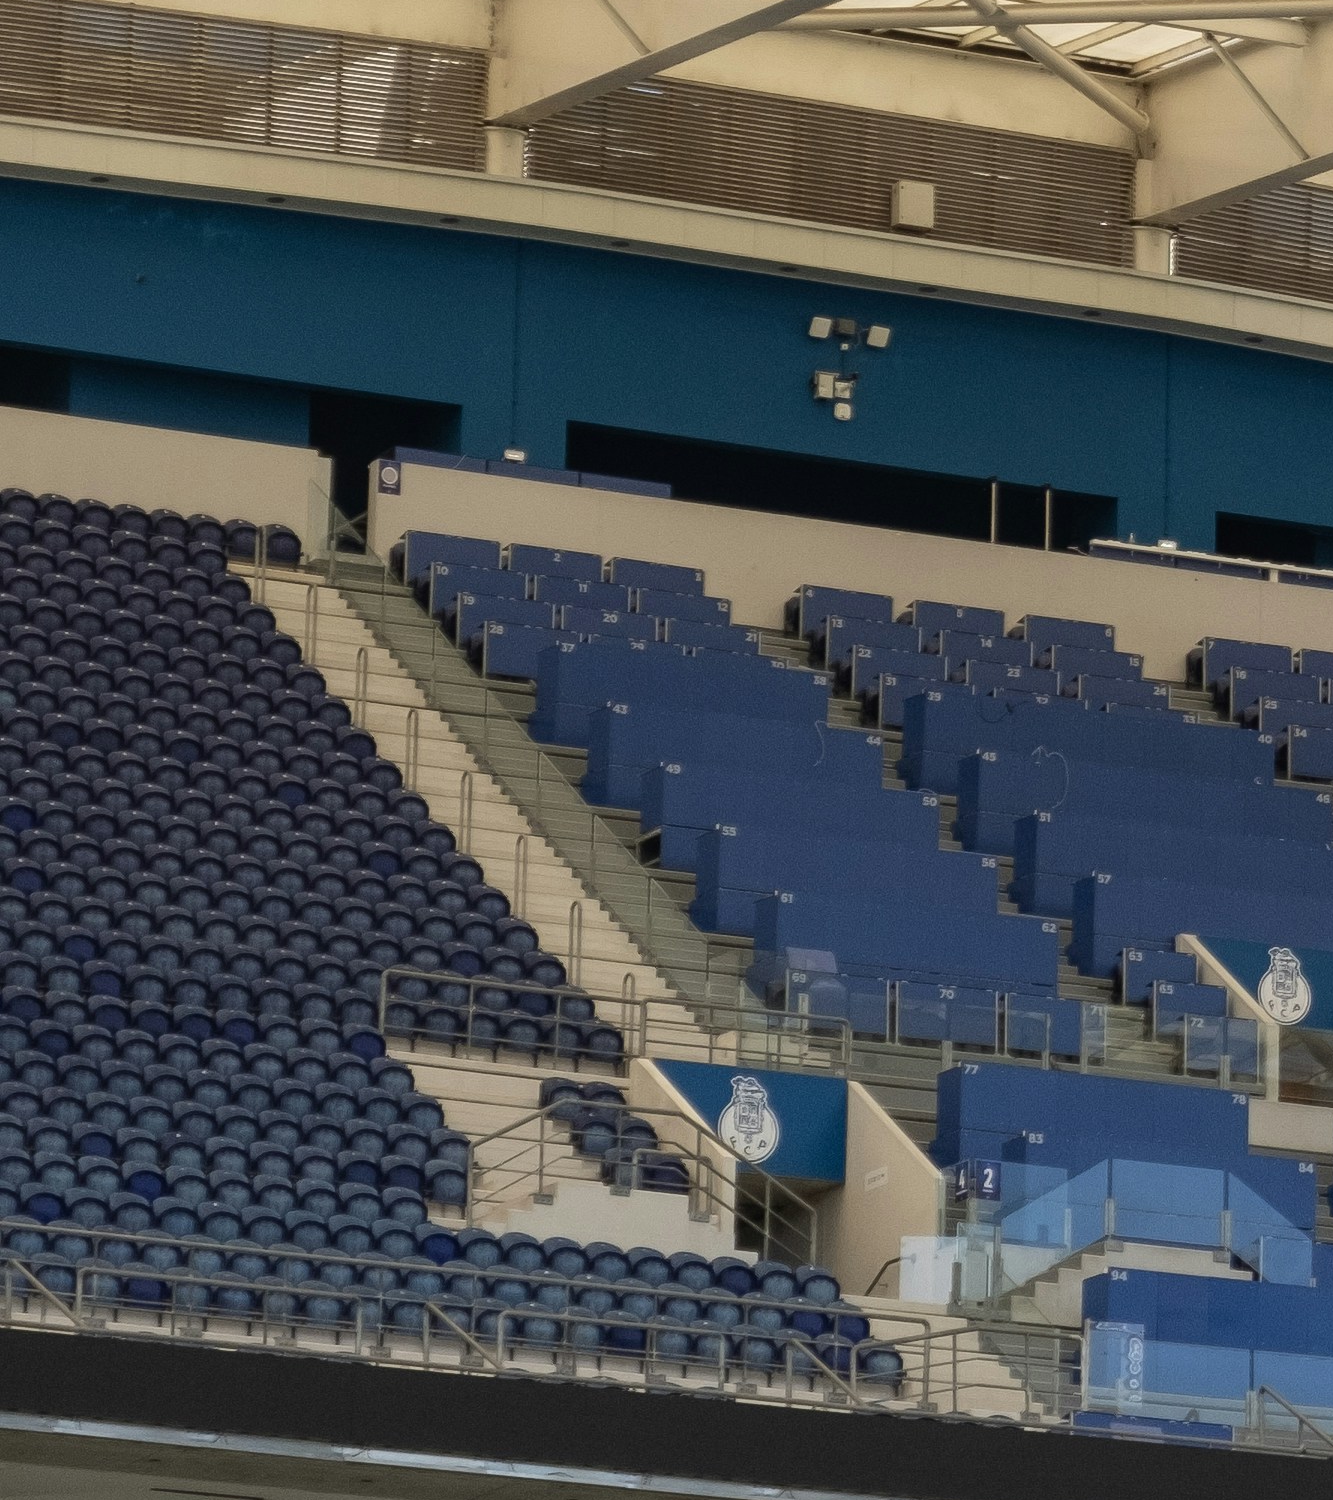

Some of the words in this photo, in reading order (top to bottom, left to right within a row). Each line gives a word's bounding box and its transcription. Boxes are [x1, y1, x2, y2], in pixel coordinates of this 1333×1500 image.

[554, 553, 560, 562] 2
[436, 565, 448, 575] 10
[579, 584, 587, 592] 11
[463, 596, 474, 605] 19
[717, 602, 728, 612] 12
[603, 613, 618, 623] 20
[832, 619, 843, 628] 13
[746, 633, 757, 642] 21
[981, 639, 992, 647] 14
[1208, 641, 1214, 650] 7
[858, 648, 871, 658] 22
[1007, 668, 1020, 677] 23
[1236, 670, 1246, 679] 16
[885, 677, 896, 686] 31
[1154, 686, 1166, 695] 24
[1265, 700, 1277, 709] 25
[1258, 734, 1273, 744] 40
[982, 752, 996, 761] 45
[923, 797, 937, 806] 50
[1097, 874, 1111, 883] 57
[781, 893, 793, 903] 61
[1042, 923, 1056, 933] 62
[1128, 951, 1142, 961] 63
[792, 973, 806, 983] 69
[940, 989, 954, 999] 70
[1159, 985, 1173, 994] 65
[1191, 1018, 1204, 1027] 72
[964, 1064, 978, 1074] 77
[1232, 1095, 1246, 1104] 78
[1029, 1134, 1043, 1144] 83
[1299, 1163, 1313, 1173] 84
[983, 1168, 993, 1188] 2
[1111, 1271, 1127, 1281] 94
